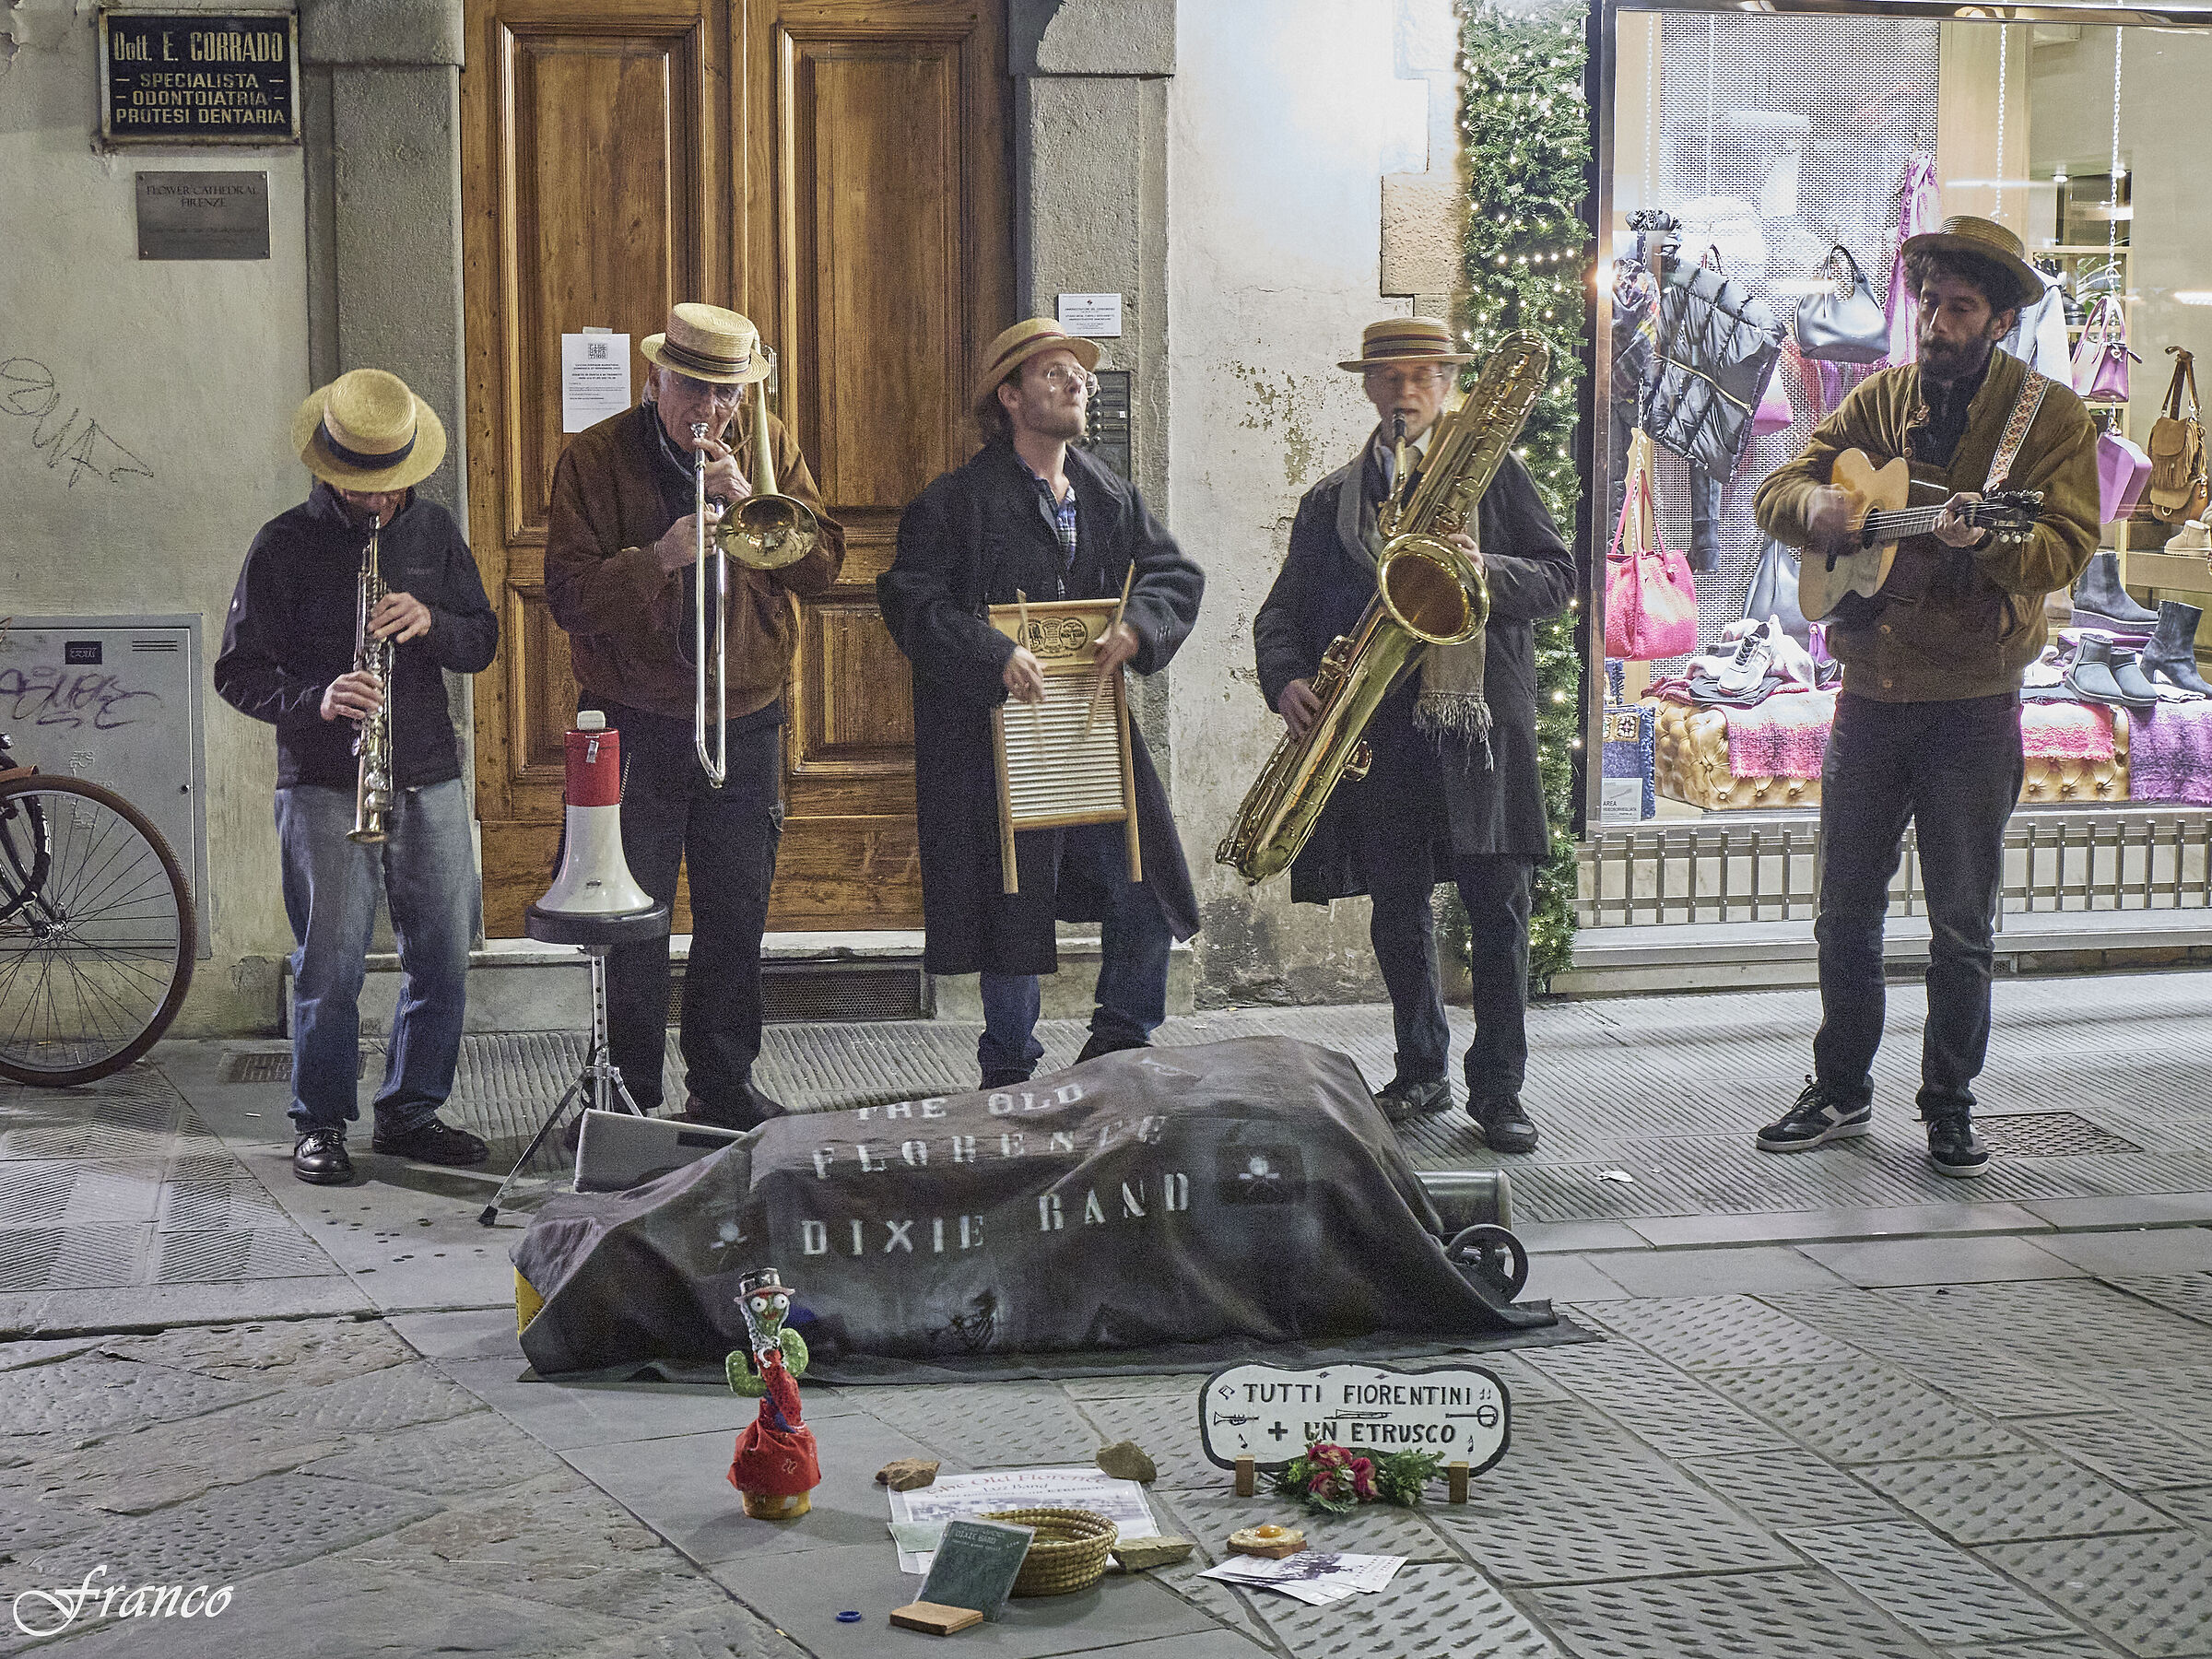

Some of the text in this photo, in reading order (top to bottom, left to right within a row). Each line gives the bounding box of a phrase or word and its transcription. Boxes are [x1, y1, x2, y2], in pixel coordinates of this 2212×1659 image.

[114, 31, 284, 63] Dott. E. CORRADO
[140, 73, 259, 88] SPECIALISTA
[132, 90, 268, 106] ODONTOIATRIA
[116, 108, 286, 124] PROTESI DENTARIA
[146, 185, 259, 195] FLOWER CATHEDRAL
[181, 197, 228, 208] FIRENZE
[857, 1083, 1085, 1121] THE OLD
[801, 1172, 1189, 1255] DIXIE BAND
[1243, 1383, 1471, 1406] TUTTI FIORENTINI
[1304, 1421, 1336, 1441] UN
[1351, 1422, 1455, 1443] ETRUSCO
[971, 1475, 1009, 1485] Old
